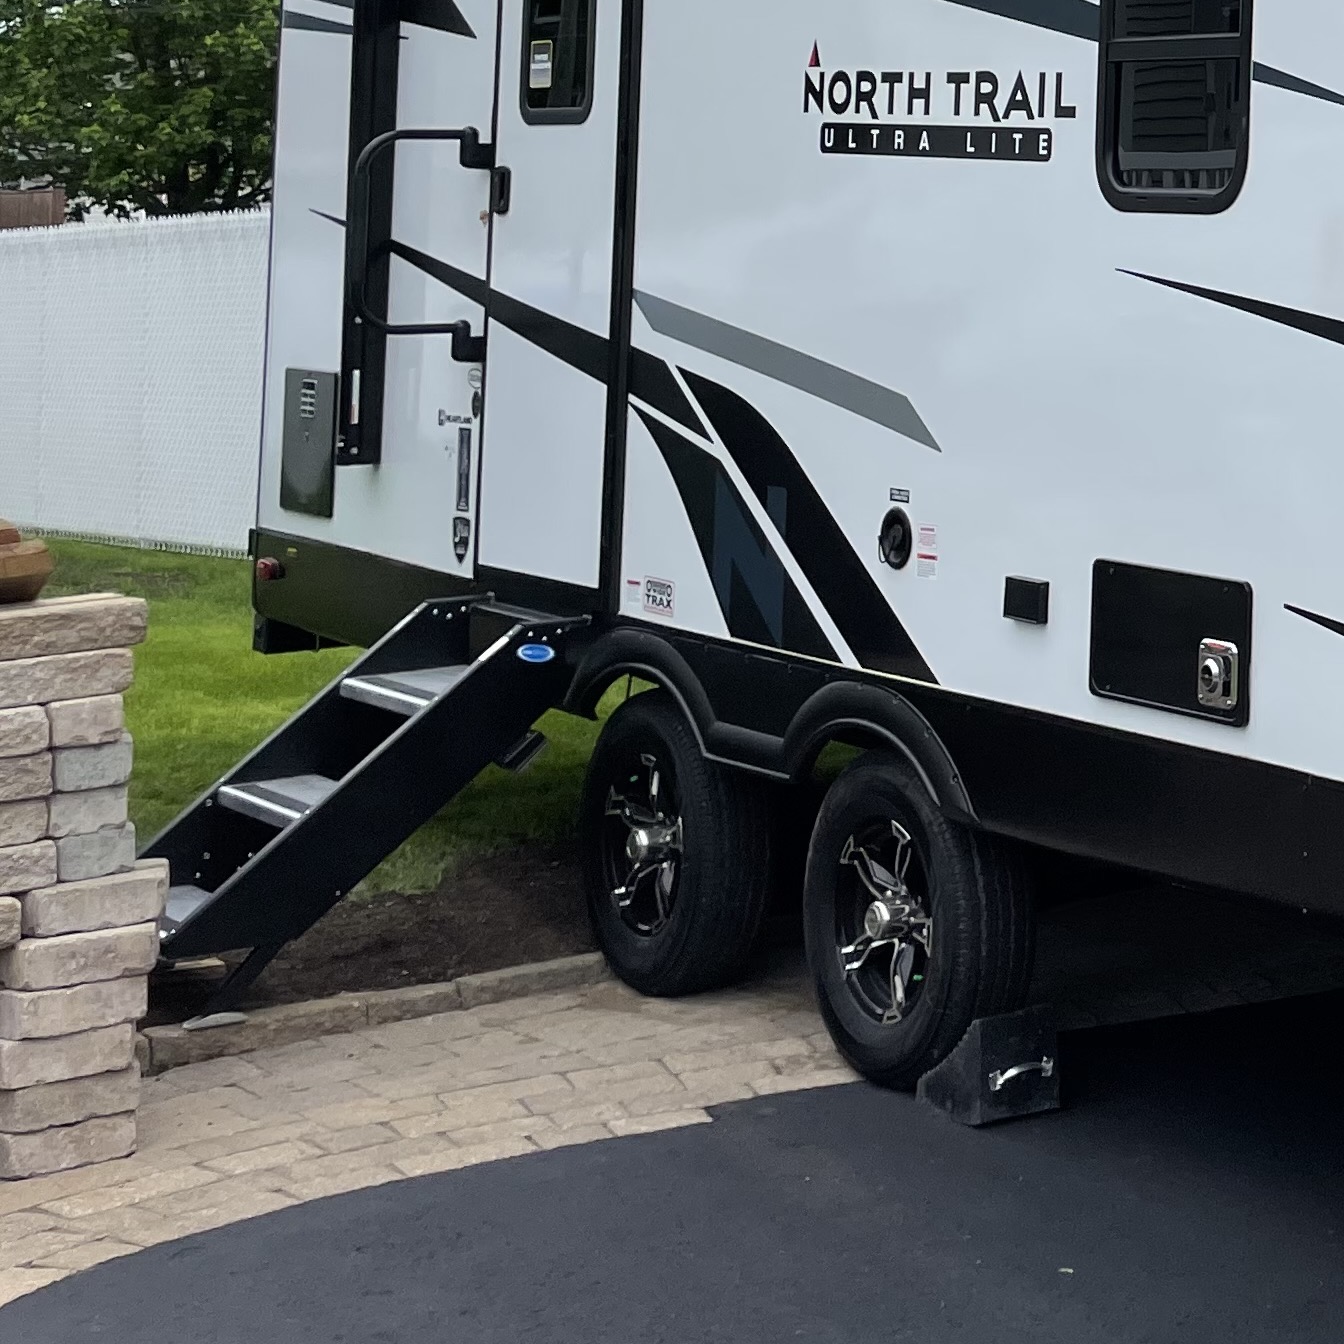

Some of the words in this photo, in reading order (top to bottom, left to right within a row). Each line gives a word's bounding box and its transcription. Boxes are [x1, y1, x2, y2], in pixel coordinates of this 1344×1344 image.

[803, 69, 932, 120] NORTH
[946, 69, 1077, 122] TRAIL
[824, 127, 930, 151] ULTRA
[966, 132, 1049, 155] LITE
[645, 593, 673, 609] TRAX
